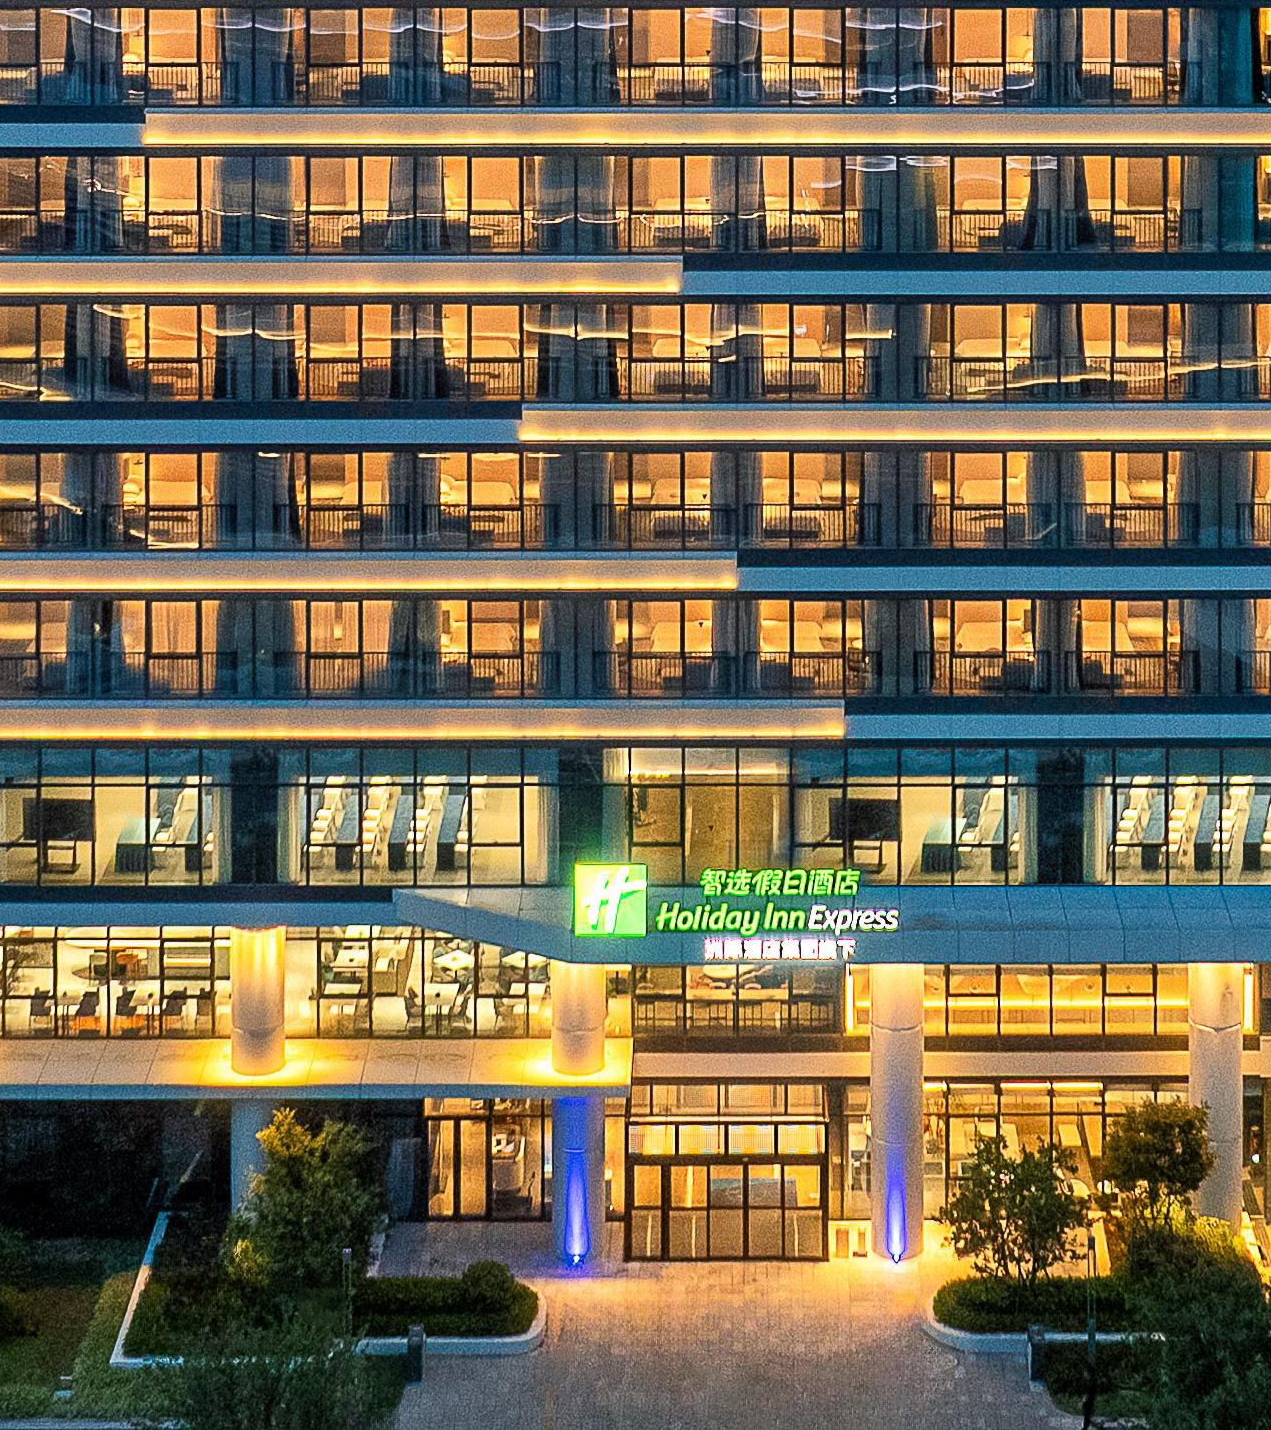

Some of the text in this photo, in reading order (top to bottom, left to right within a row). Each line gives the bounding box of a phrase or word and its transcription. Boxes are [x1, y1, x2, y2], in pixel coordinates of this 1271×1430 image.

[700, 868, 861, 897] 智选假日酒店
[656, 902, 899, 937] Holiday Inn Express
